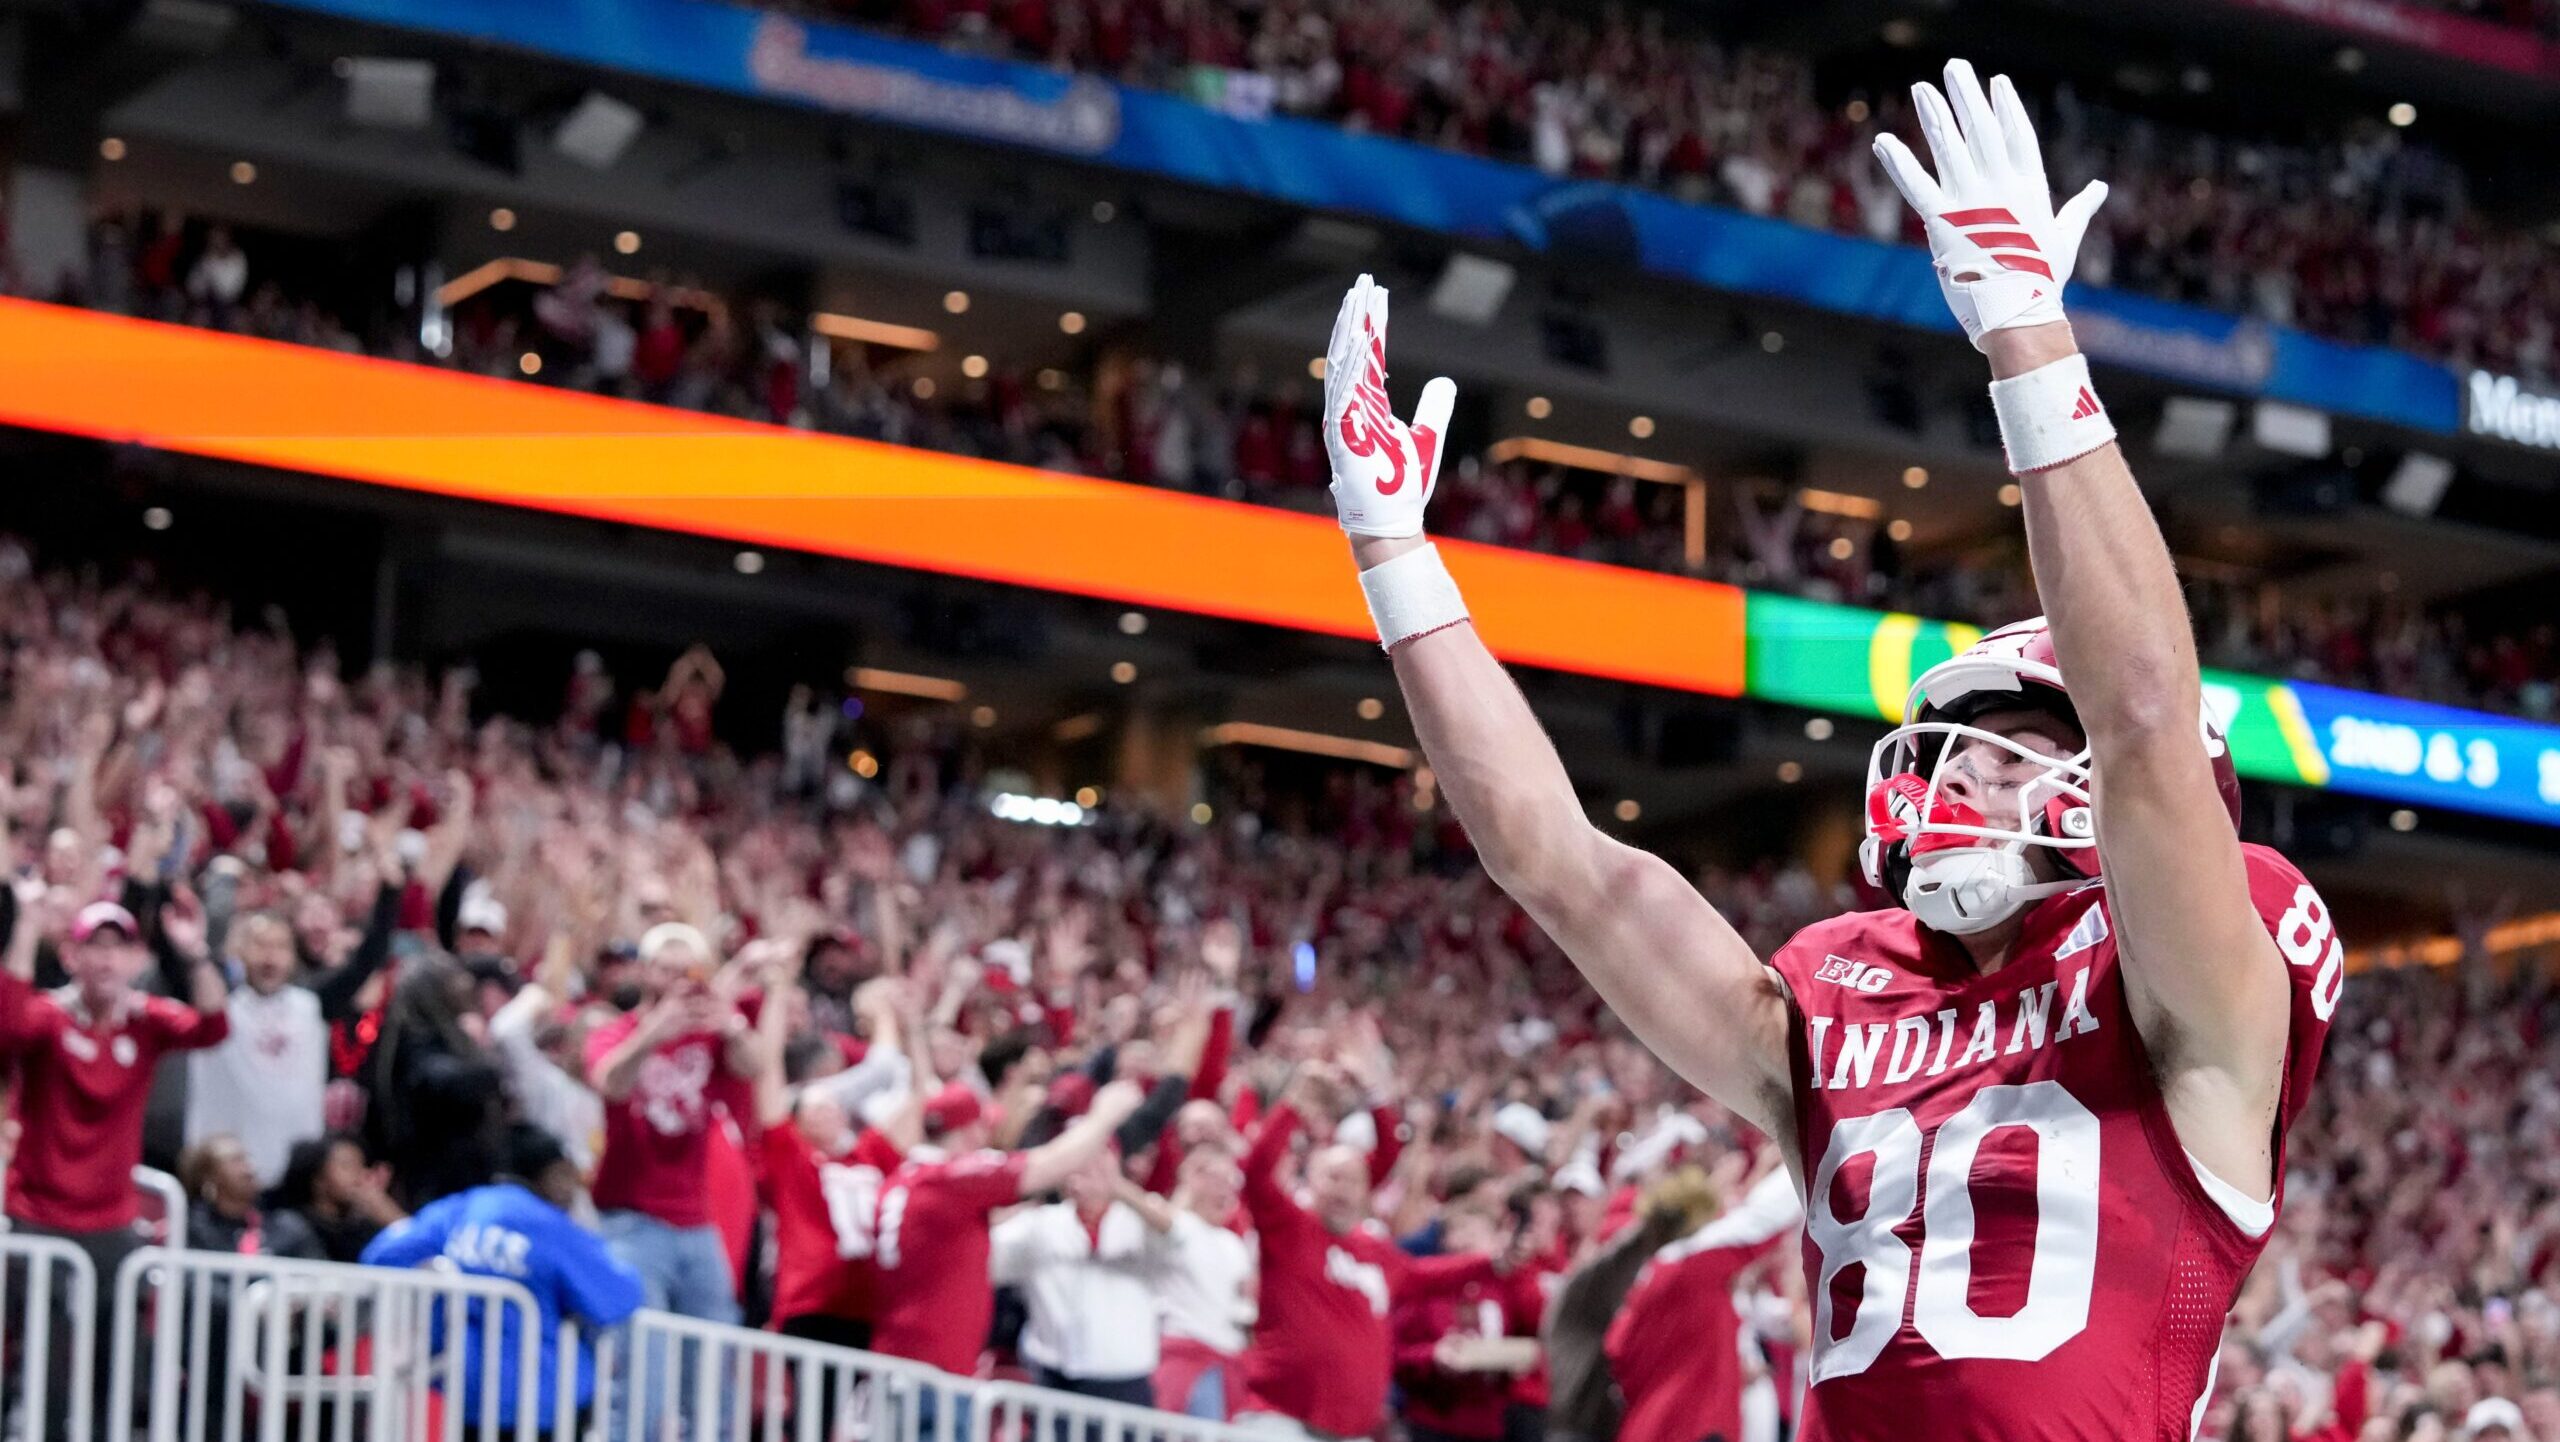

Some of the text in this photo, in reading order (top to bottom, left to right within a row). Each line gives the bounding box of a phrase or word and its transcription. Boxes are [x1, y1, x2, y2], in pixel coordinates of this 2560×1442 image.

[2276, 884, 2344, 1022] 80
[1811, 967, 2099, 1090] INDIANA
[1807, 1080, 2100, 1388] 80
